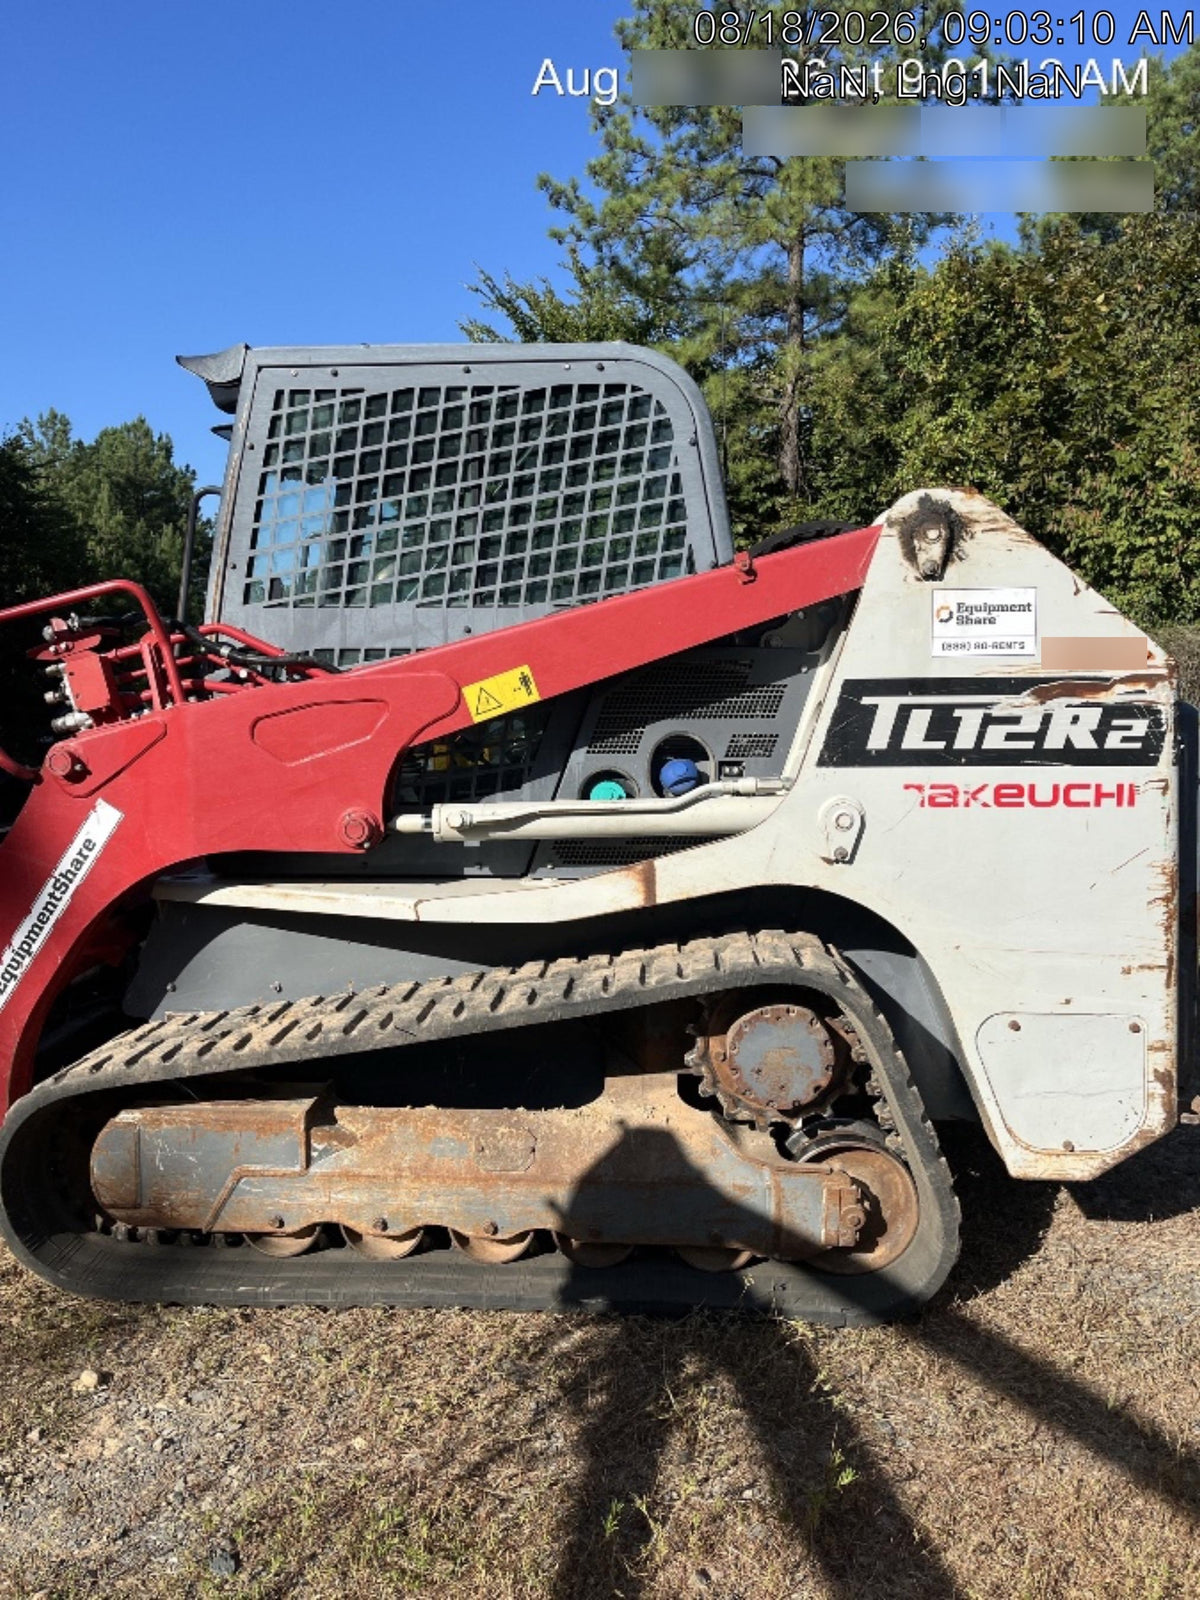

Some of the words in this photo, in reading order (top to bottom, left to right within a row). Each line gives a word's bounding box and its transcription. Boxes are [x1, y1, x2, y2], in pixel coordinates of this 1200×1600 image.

[955, 602, 1032, 616] Equipment
[955, 614, 997, 626] Share
[859, 695, 1151, 751] TL12R2
